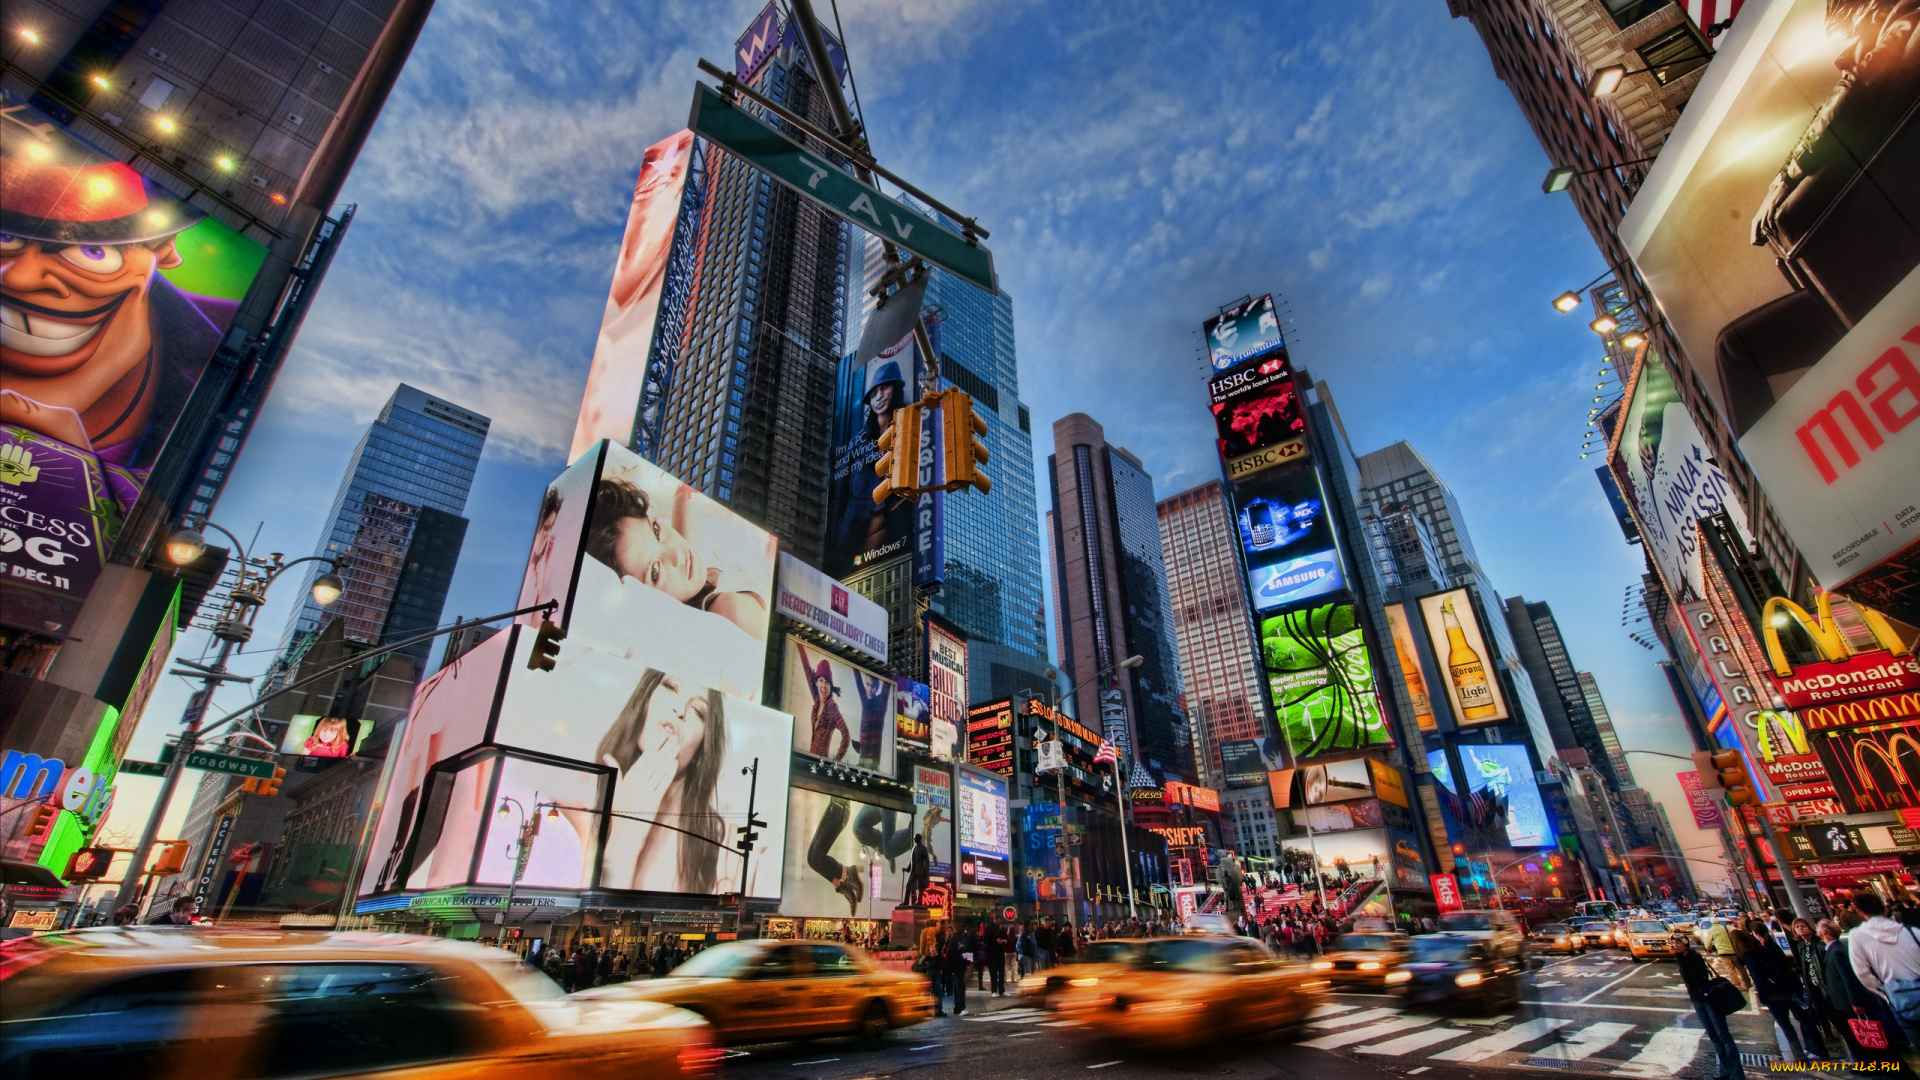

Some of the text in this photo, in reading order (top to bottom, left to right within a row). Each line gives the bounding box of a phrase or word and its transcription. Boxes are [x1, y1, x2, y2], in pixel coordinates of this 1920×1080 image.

[738, 14, 774, 67] W
[799, 155, 828, 190] 7
[658, 268, 684, 378] AMERICAN
[1232, 336, 1282, 362] Prudential
[1211, 368, 1257, 395] HSBC
[1213, 370, 1288, 403] The world's local bank
[1795, 325, 1920, 486] ma
[834, 438, 880, 469] and Windo
[835, 431, 867, 457] I'm a PC
[834, 466, 850, 481] was
[850, 458, 865, 472] my
[1230, 450, 1277, 476] HSBC
[918, 430, 934, 552] SQUARE
[1664, 454, 1702, 525] NINJA
[1294, 508, 1314, 519] JACK
[1894, 504, 1918, 521] DATA
[863, 536, 908, 563] Windows 7
[1831, 527, 1880, 561] RECORDABLE
[918, 564, 932, 574] NYC
[1836, 551, 1861, 569] MEDIA
[11, 565, 52, 585] DEC.
[54, 575, 70, 590] 11
[1268, 568, 1326, 591] SAMSUNG
[781, 590, 886, 656] READY FOR HOLIDAY CHEER
[932, 649, 964, 676] MUSICAL
[939, 642, 957, 661] BEST
[932, 663, 954, 699] BILLY
[1270, 668, 1328, 686] display powered
[1452, 665, 1483, 678] Corona
[1697, 611, 1777, 757] PALACE
[1782, 657, 1920, 695] McDonald's
[1274, 677, 1328, 694] by wind energy
[1461, 685, 1488, 700] Light
[1810, 678, 1904, 701] Restaurant
[932, 690, 959, 726] ELLIOT
[136, 763, 145, 772] 7
[191, 756, 259, 775] roadway
[918, 767, 950, 789] HEIGHTS
[916, 793, 928, 805] BEST
[1132, 788, 1163, 799] Reese's
[1785, 788, 1812, 797] OPEN
[1149, 827, 1204, 846] SHEY'S
[191, 820, 229, 914] SCIENTOLOG
[411, 897, 450, 907] AMERICAN
[452, 896, 487, 906] EAGLE
[1437, 876, 1454, 906] tkts
